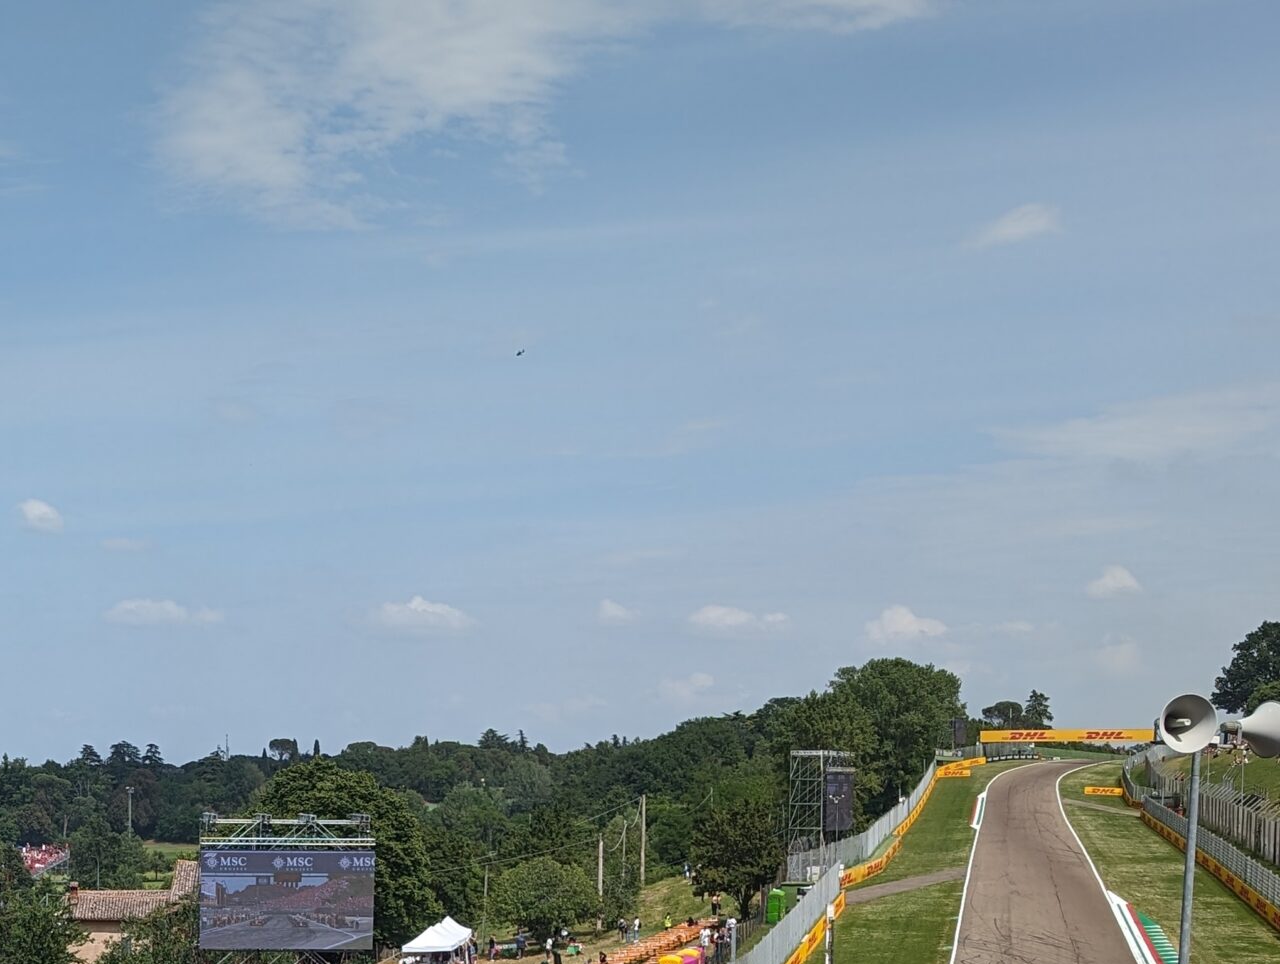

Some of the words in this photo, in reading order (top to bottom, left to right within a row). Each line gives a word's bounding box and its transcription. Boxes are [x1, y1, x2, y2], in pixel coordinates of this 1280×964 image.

[1009, 732, 1048, 740] DHL
[1086, 731, 1125, 740] DHL
[220, 856, 247, 866] MSC
[287, 856, 313, 867] MSC
[867, 860, 883, 876] DHL
